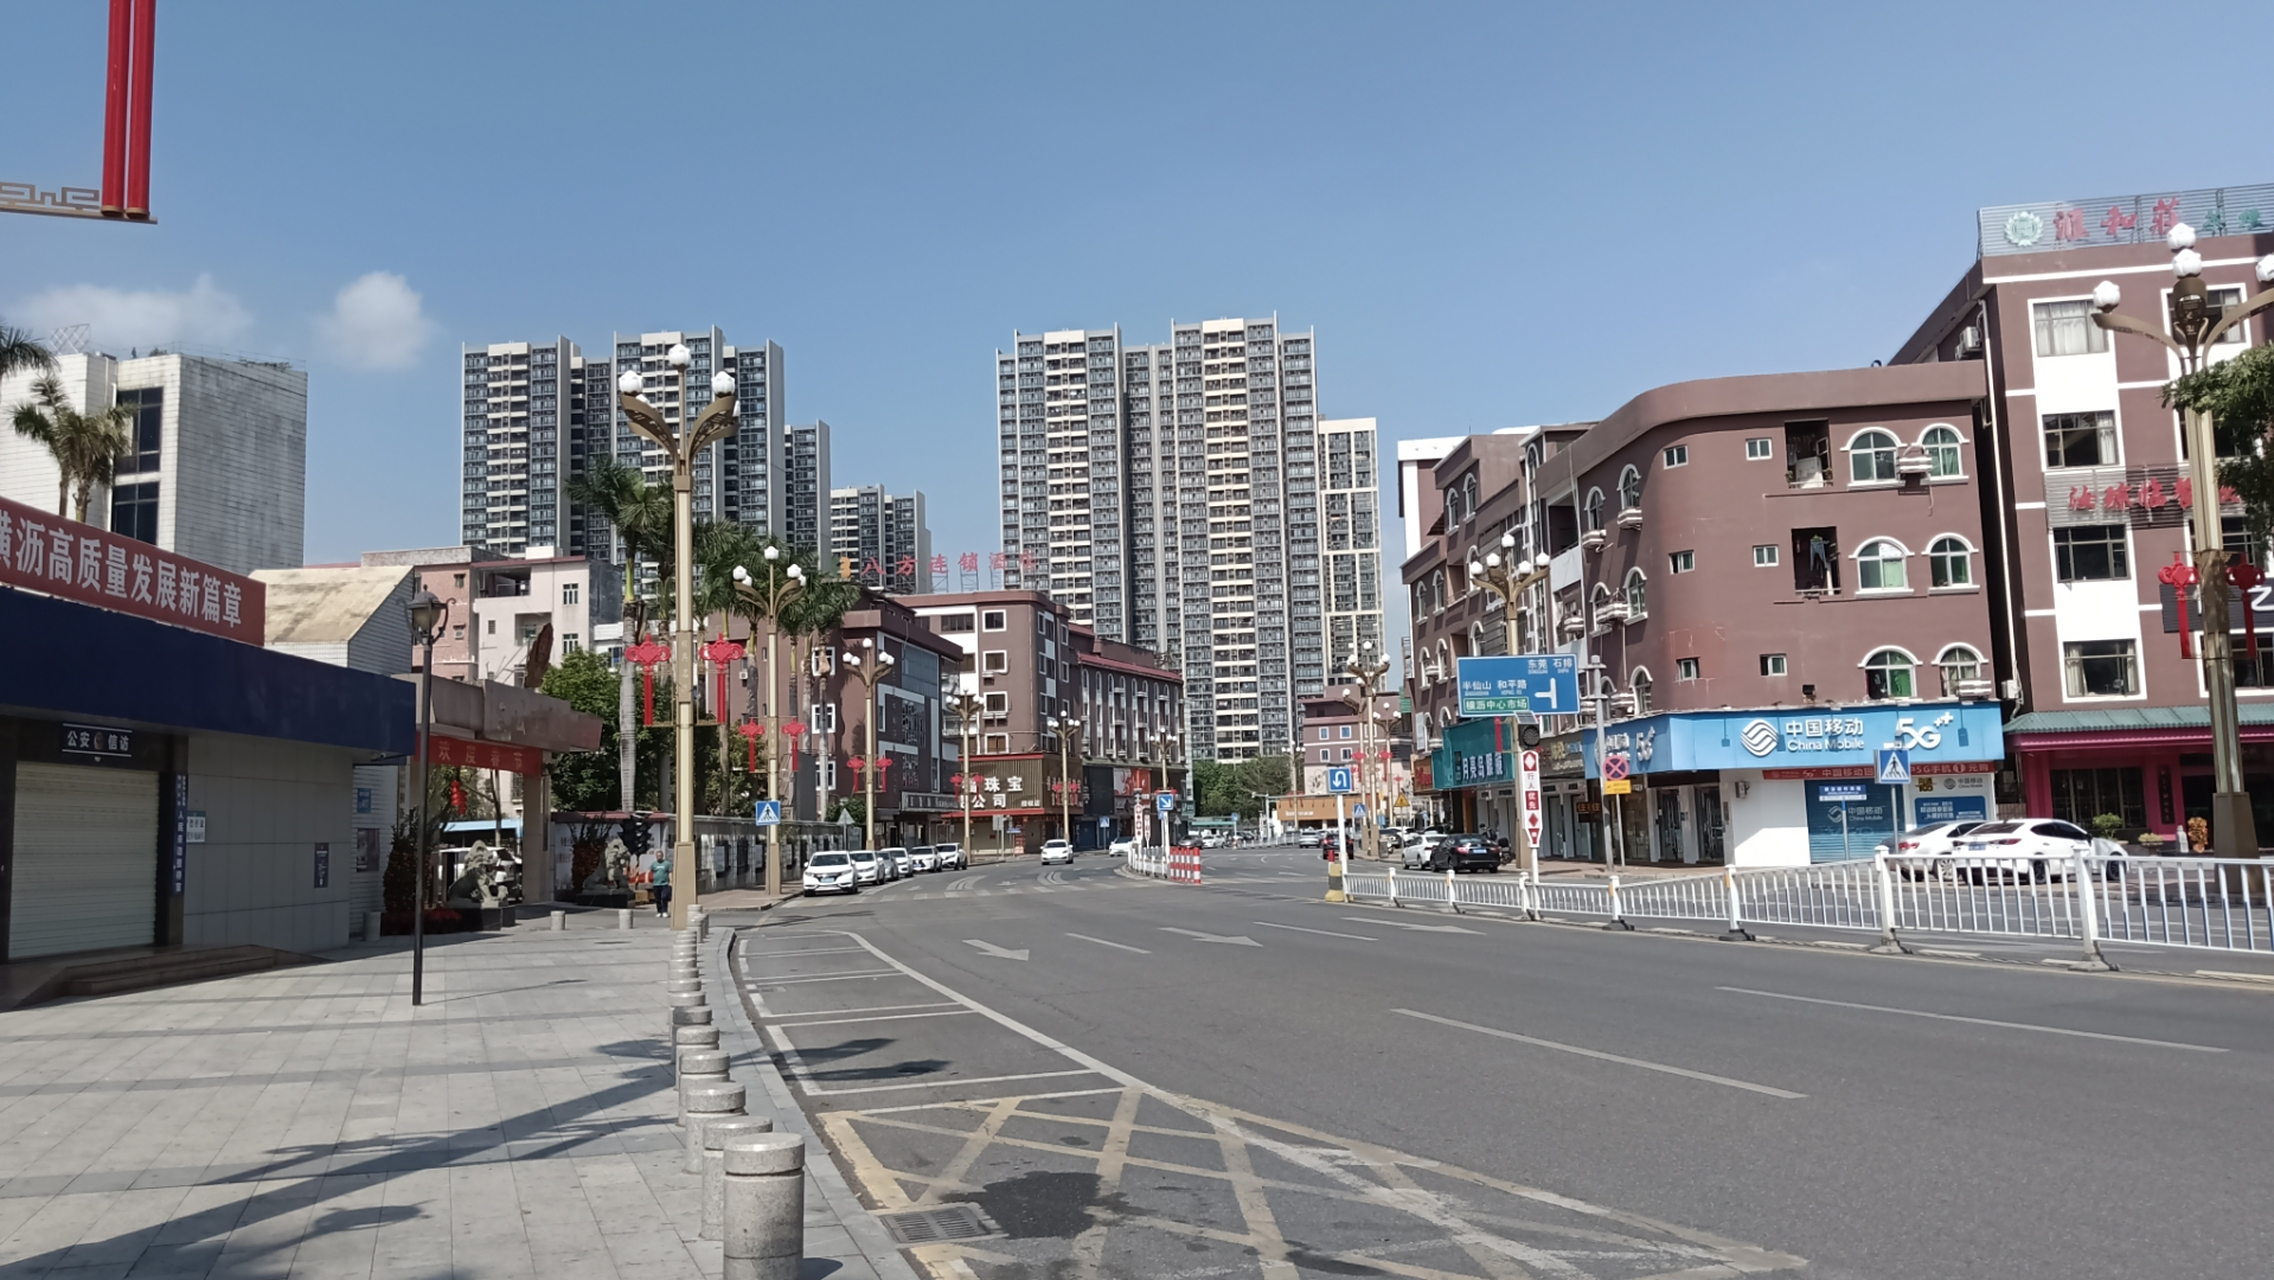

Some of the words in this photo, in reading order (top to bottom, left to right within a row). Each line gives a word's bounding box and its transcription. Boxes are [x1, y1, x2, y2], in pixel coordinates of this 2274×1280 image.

[862, 550, 1036, 576] 八方连锁酒店
[1527, 658, 1548, 670] 东莞
[1552, 657, 1573, 669] 石排
[1462, 680, 1492, 691] 半仙山
[1497, 679, 1527, 691] 和平路
[1465, 698, 1528, 711] 横沥中心市场
[1785, 717, 1864, 738] 中国移动
[67, 730, 90, 748] 公安
[107, 734, 130, 751] 信访
[1787, 739, 1822, 753] China
[1825, 738, 1865, 751] Mobile
[437, 740, 523, 769] 欢度春节
[1848, 806, 1883, 816] 中国移动
